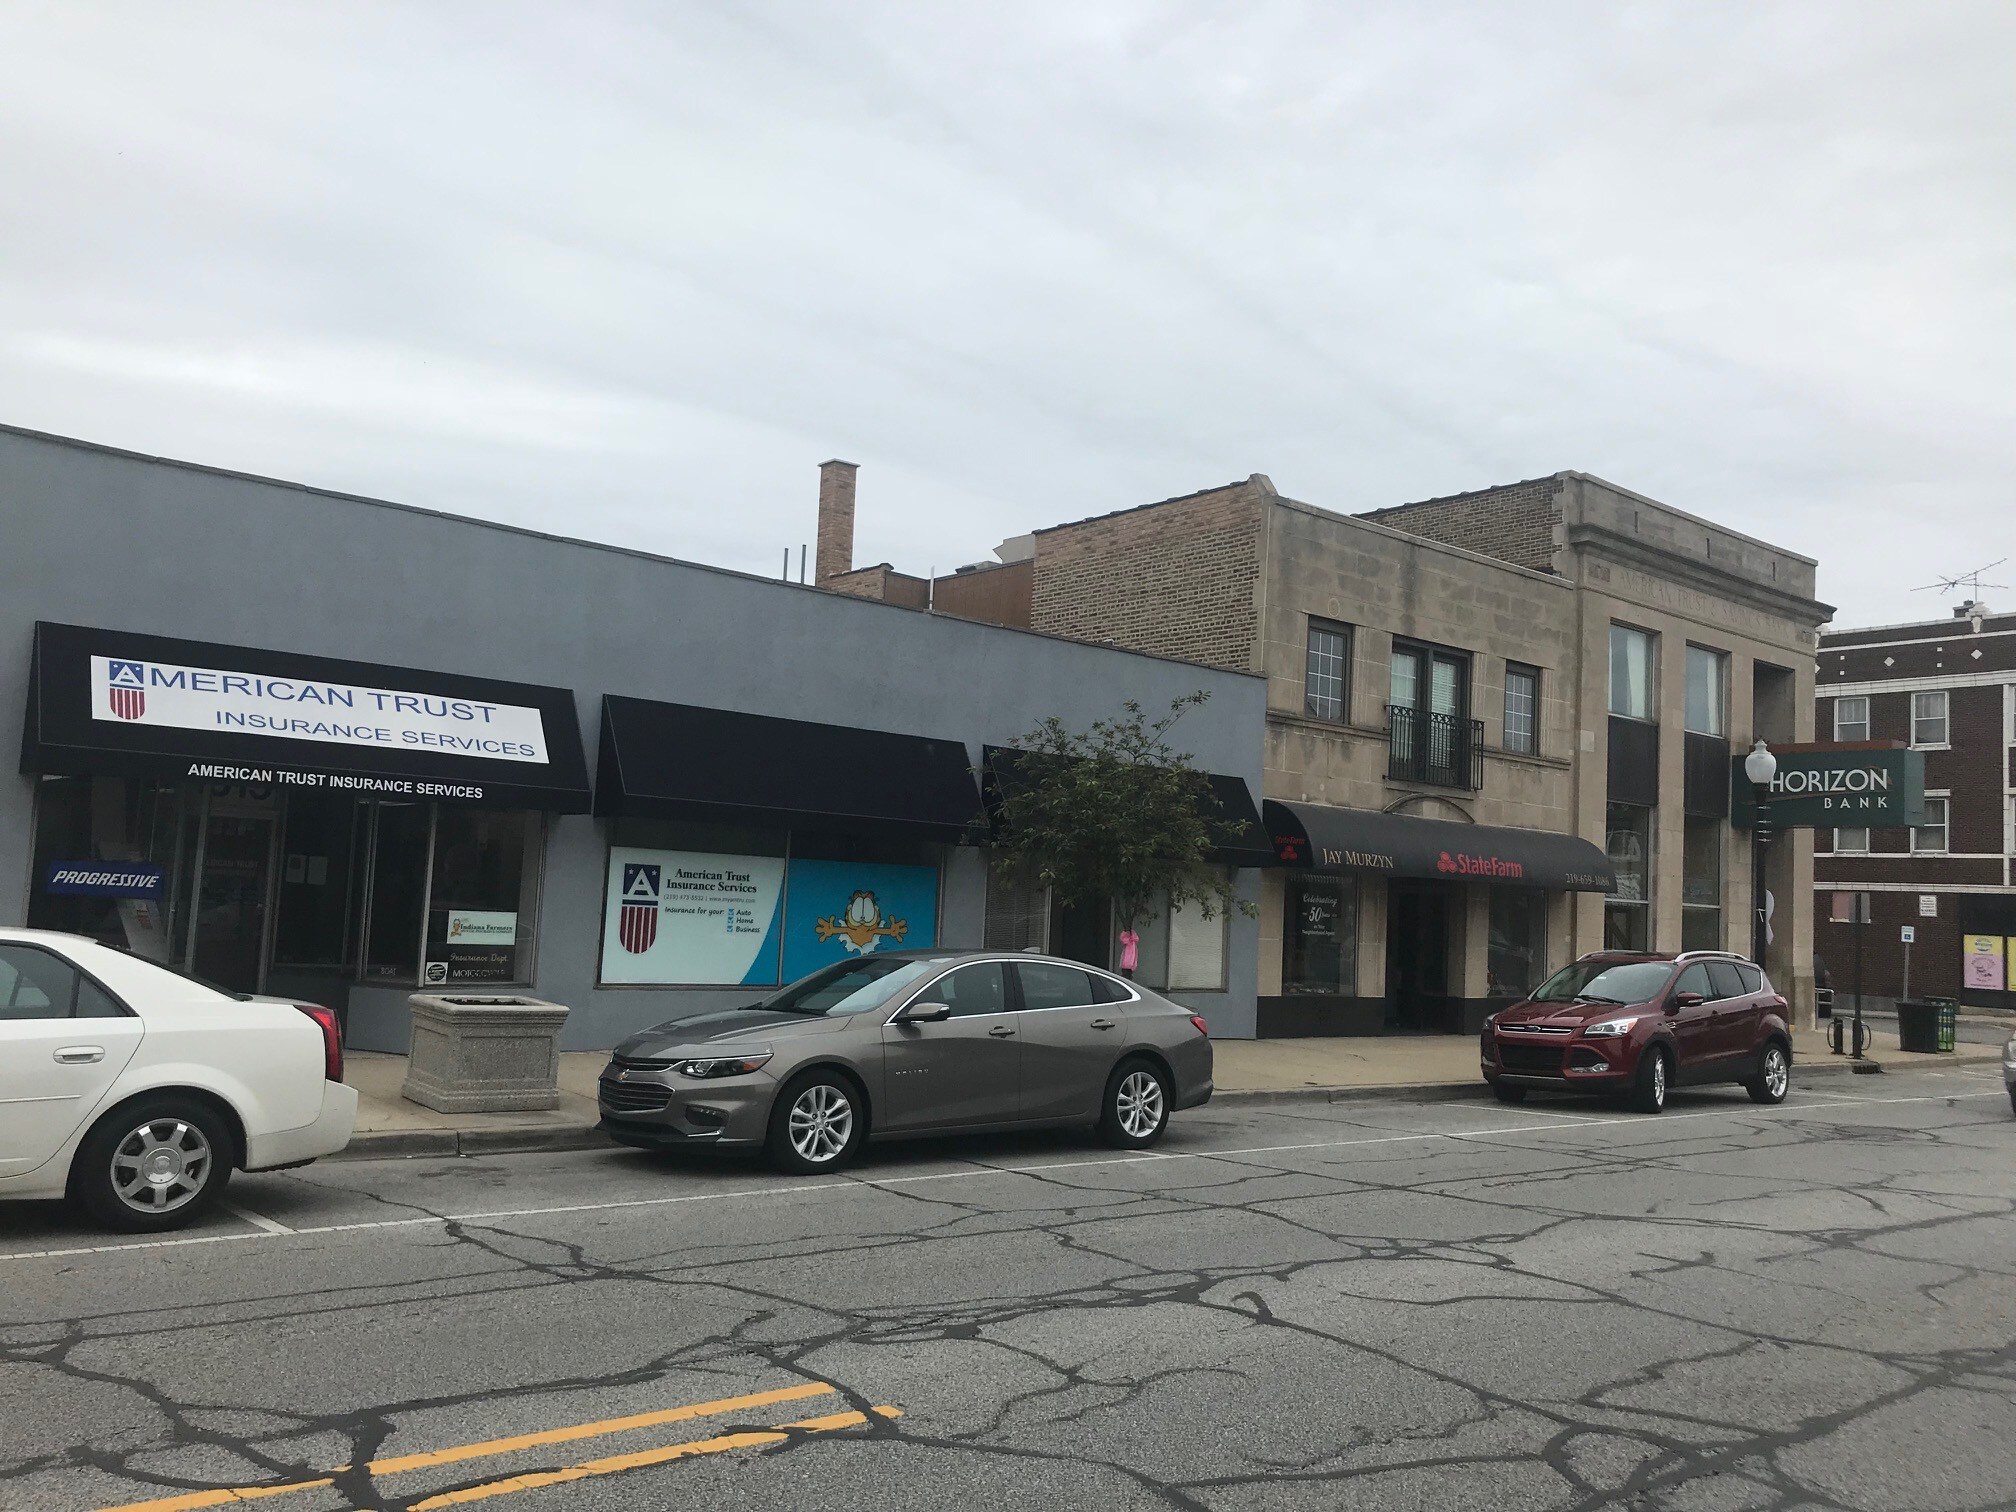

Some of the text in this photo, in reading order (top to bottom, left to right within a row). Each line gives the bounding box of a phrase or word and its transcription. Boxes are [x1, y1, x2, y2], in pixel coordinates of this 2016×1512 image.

[367, 692, 497, 723] TRUST
[216, 710, 536, 757] INSURANCE SERVICES
[187, 763, 483, 799] AMERICAN TRUST INSURANCE SERVICES
[1769, 768, 1888, 793] HORIZON
[1823, 796, 1888, 809] BANK
[52, 870, 160, 888] PROGRESSIVE
[674, 868, 750, 882] American Trust
[666, 878, 757, 893] Insurance Services
[664, 906, 695, 914] Insurance
[709, 909, 725, 917] your:
[1308, 906, 1322, 922] 50
[735, 925, 760, 933] Business
[450, 952, 488, 963] Insurance
